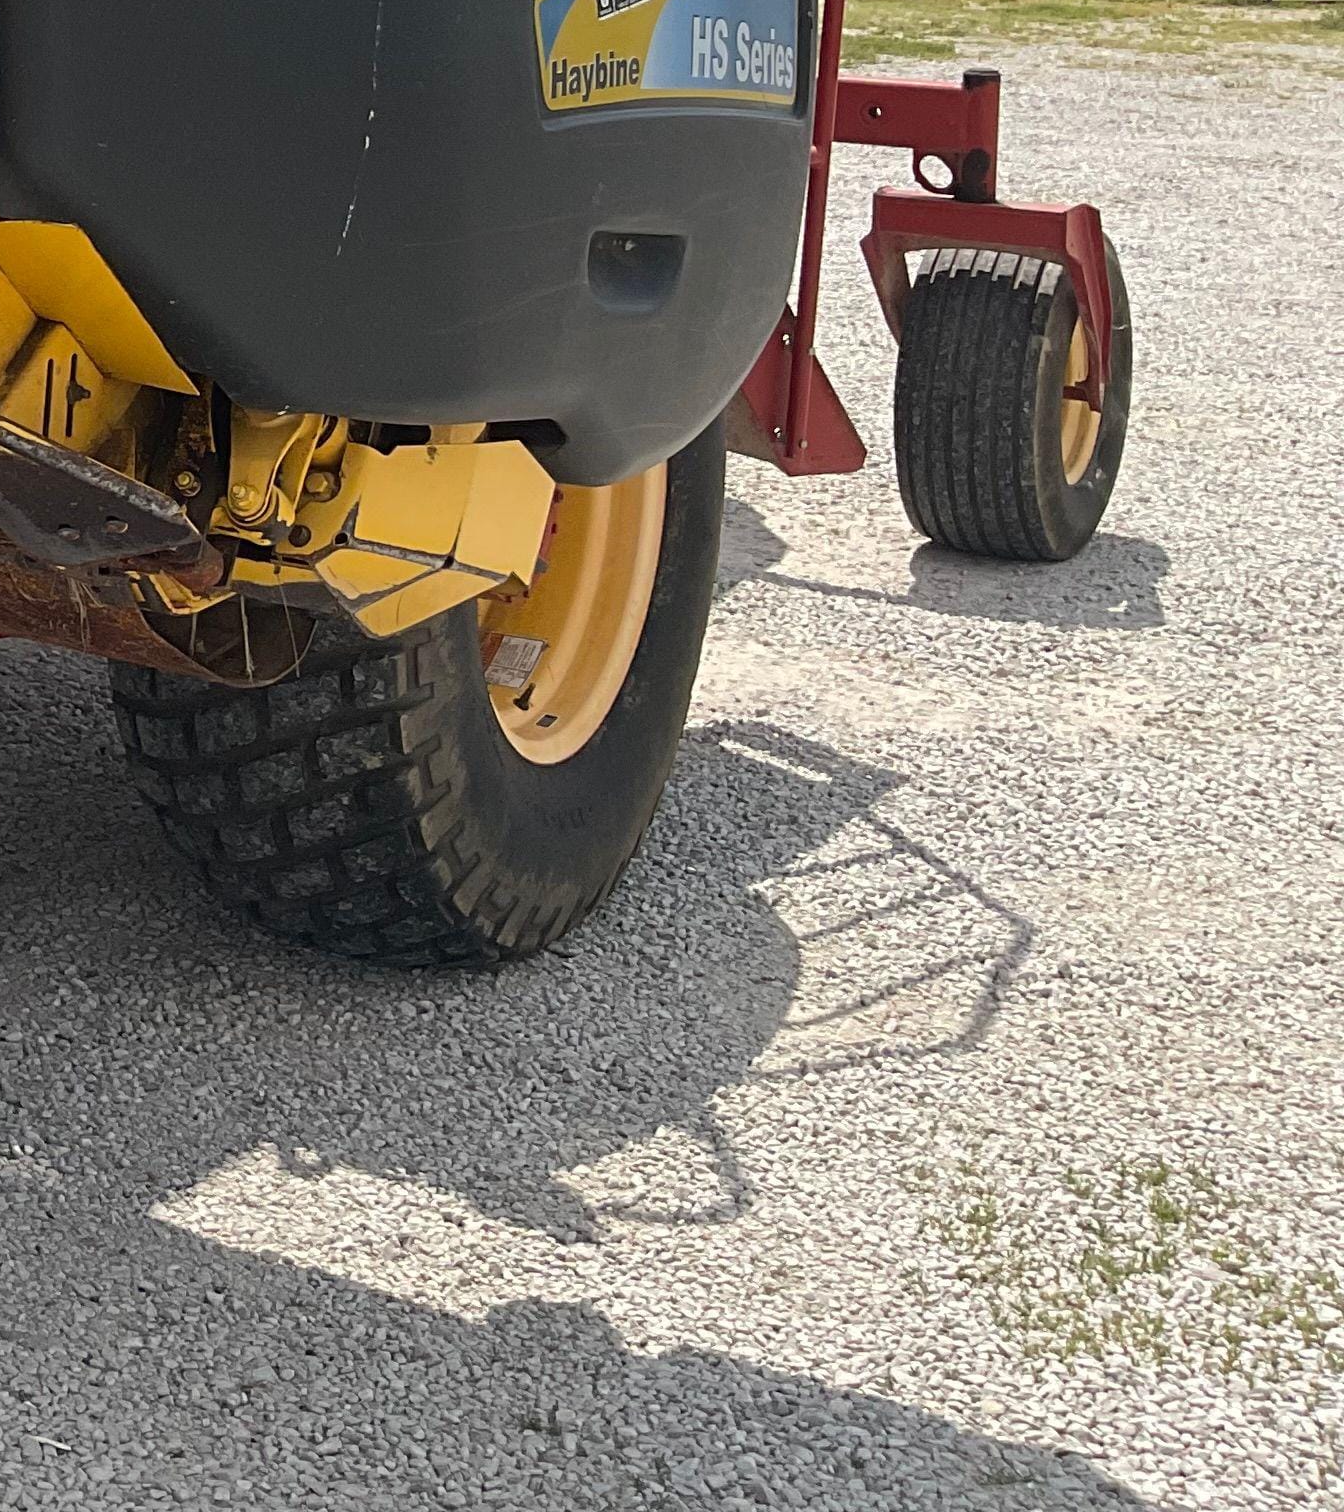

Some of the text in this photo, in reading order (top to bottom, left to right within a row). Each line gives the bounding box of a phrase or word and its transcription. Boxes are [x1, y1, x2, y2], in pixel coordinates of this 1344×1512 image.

[551, 51, 640, 102] Haybine
[691, 15, 794, 89] HS Series
